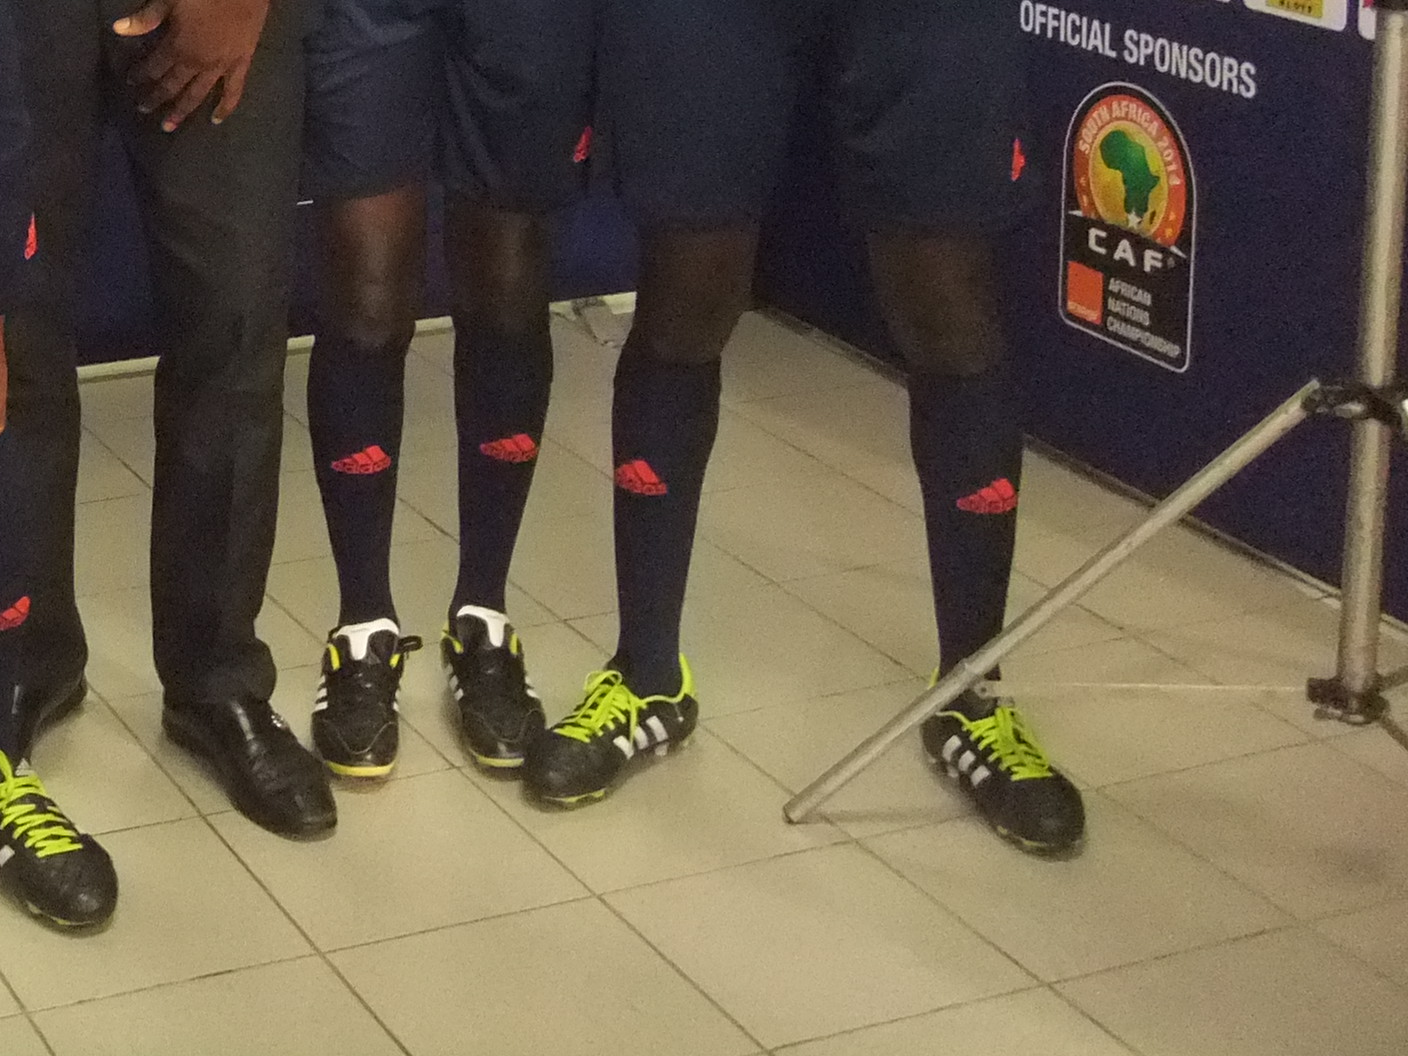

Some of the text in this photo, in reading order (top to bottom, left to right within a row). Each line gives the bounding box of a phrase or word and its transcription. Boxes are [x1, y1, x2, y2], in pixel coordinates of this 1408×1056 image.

[1020, 0, 1257, 98] OFFICIAL SPONSORS
[1078, 100, 1182, 186] SOUTH AFRICA 2014
[1088, 227, 1163, 272] CAF
